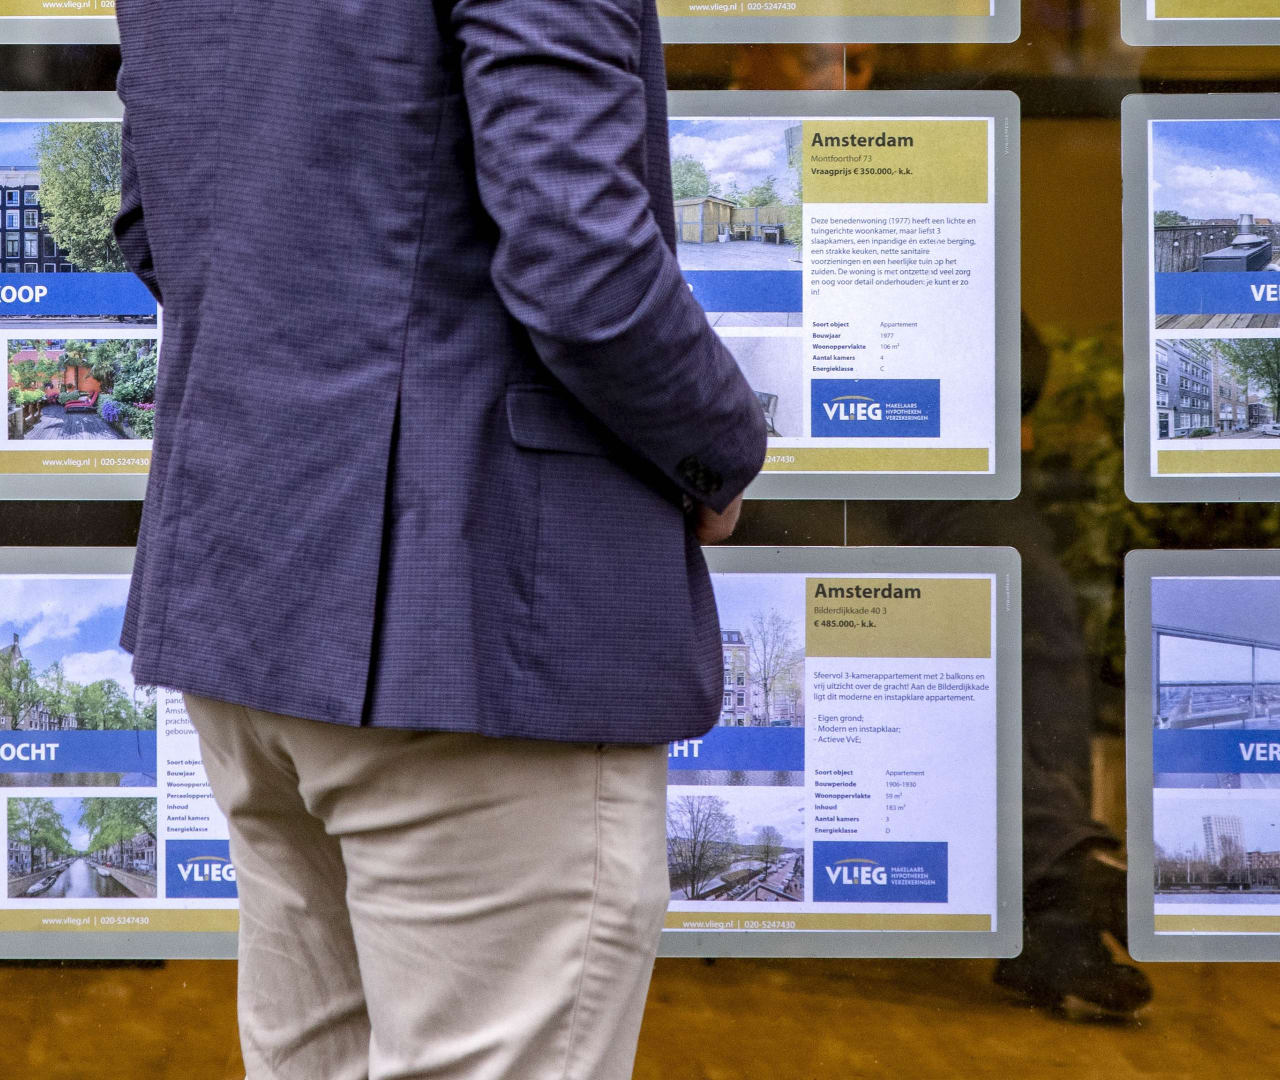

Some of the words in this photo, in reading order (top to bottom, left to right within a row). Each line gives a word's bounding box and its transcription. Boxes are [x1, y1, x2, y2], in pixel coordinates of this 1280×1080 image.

[689, 3, 737, 12] www.vlieg.nl
[747, 2, 796, 10] 020-5247430
[811, 132, 913, 147] Amsterdam
[811, 154, 862, 162] Montfoorthof
[811, 167, 852, 177] Vraagprijs
[823, 403, 882, 420] VLIEG
[42, 458, 90, 467] www.vlieg.nl
[101, 458, 150, 467] 020-5247430
[814, 583, 921, 599] Amsterdam
[814, 606, 869, 616] Bilderdijkkade
[821, 620, 860, 629] 485.000,-
[177, 862, 236, 880] VLIEG
[825, 866, 887, 885] VLIEG
